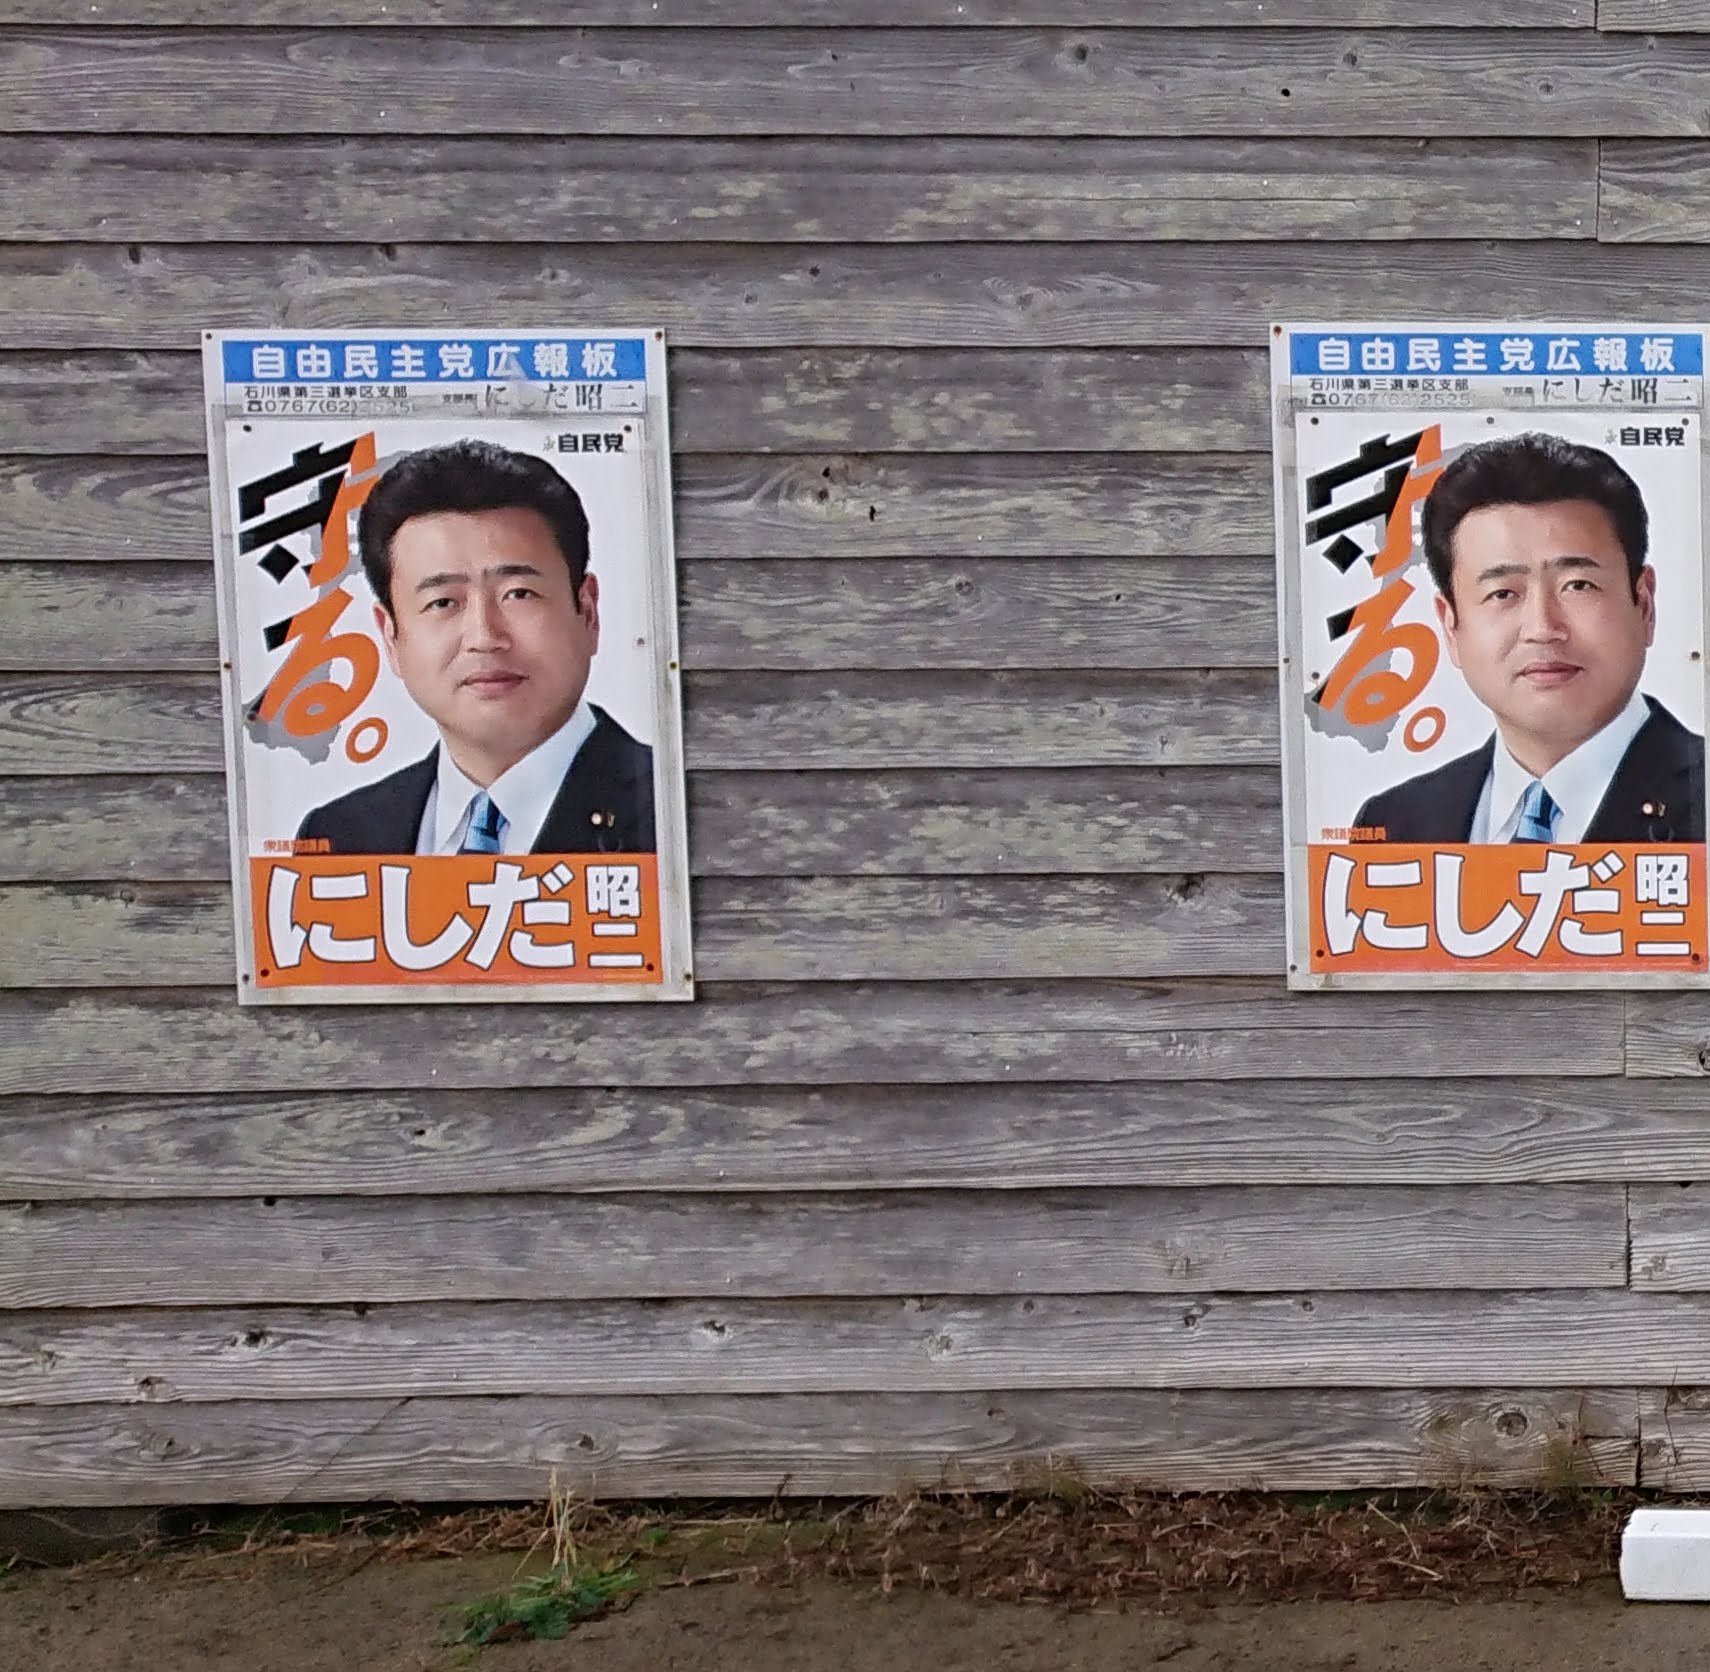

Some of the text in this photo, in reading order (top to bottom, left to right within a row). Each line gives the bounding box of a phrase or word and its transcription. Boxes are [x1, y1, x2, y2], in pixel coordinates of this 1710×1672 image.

[251, 342, 618, 380] 自由民主党広報板
[1318, 337, 1675, 372] 自由民主党広報板
[1309, 378, 1469, 391] 石川県第三選挙区支部
[558, 433, 625, 453] 自民党
[1620, 427, 1685, 446] 自民党
[238, 431, 389, 763] 守る。
[1304, 423, 1447, 753] 守る。
[266, 861, 645, 971] にしだ 昭二
[1322, 849, 1691, 959] にしだ 昭二
